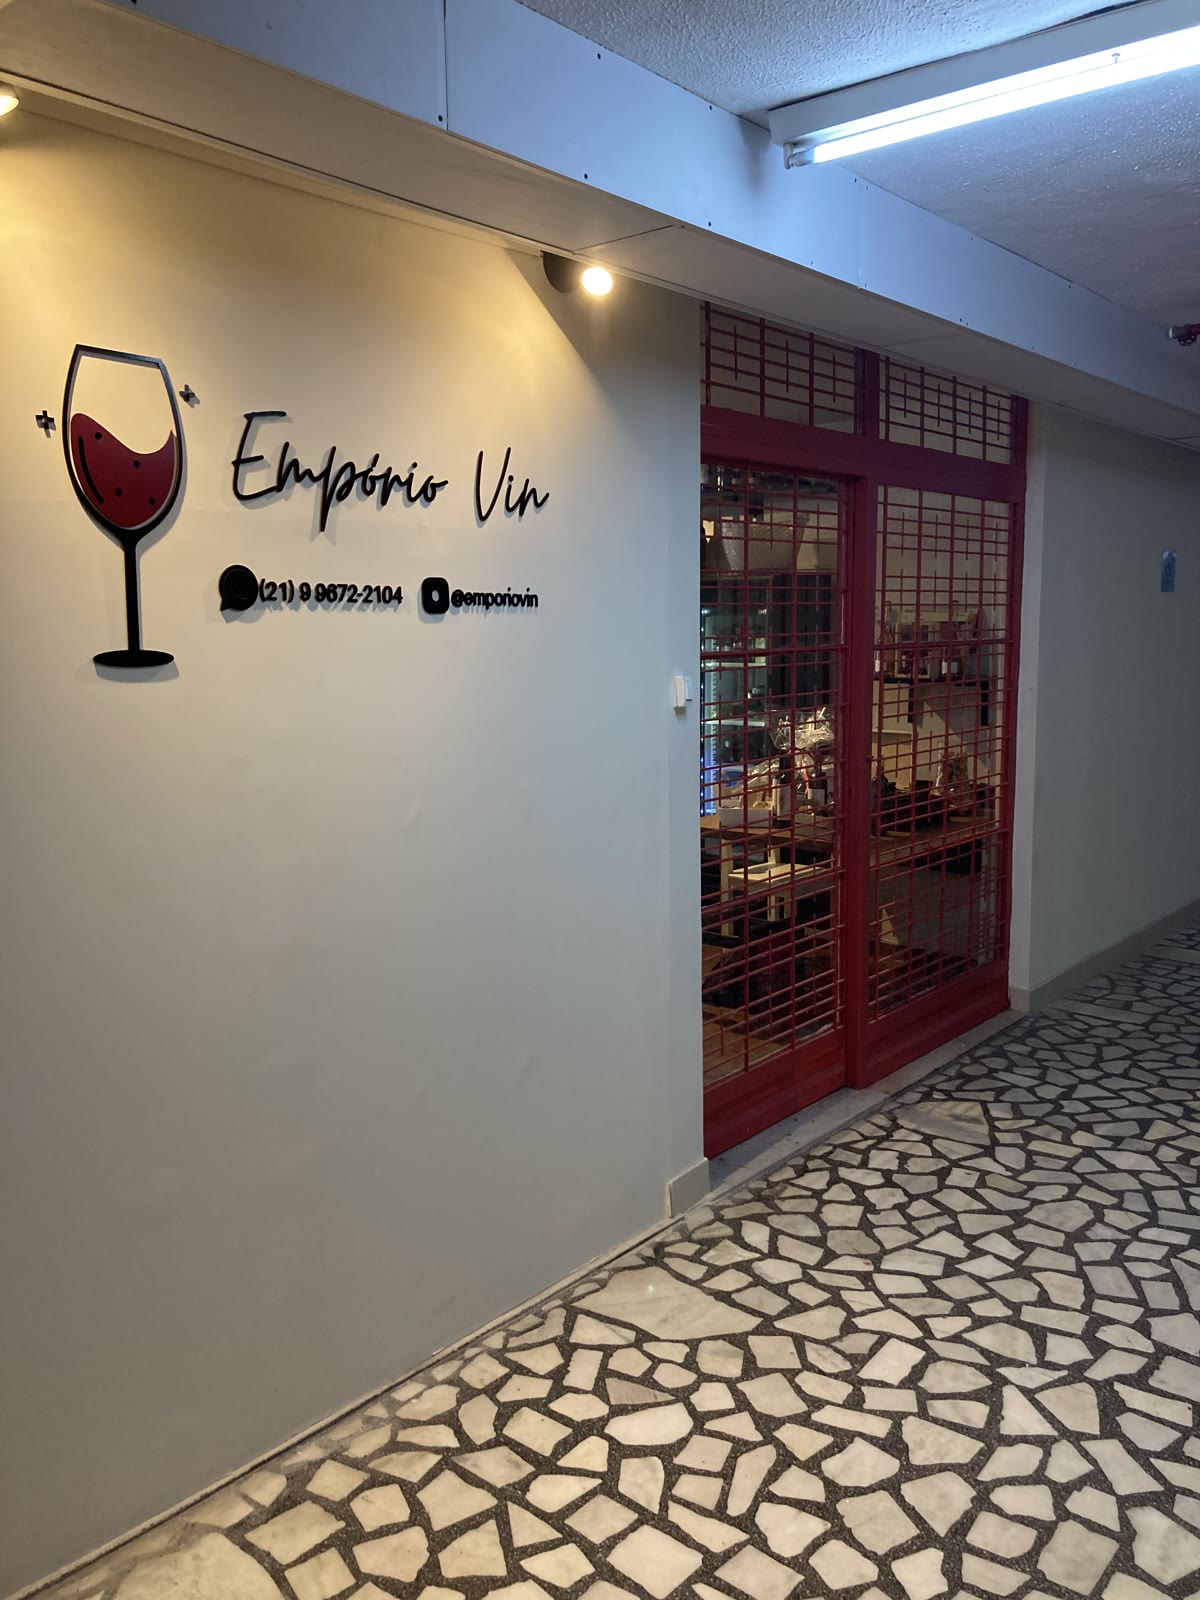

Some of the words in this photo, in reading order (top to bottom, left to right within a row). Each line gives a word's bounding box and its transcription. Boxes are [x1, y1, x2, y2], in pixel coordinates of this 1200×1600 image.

[232, 410, 448, 532] Empório
[475, 447, 550, 521] Vin
[260, 578, 294, 603] (21)
[299, 582, 311, 602] 9
[315, 583, 403, 605] 9672-2104
[451, 587, 539, 611] @emporiovin
